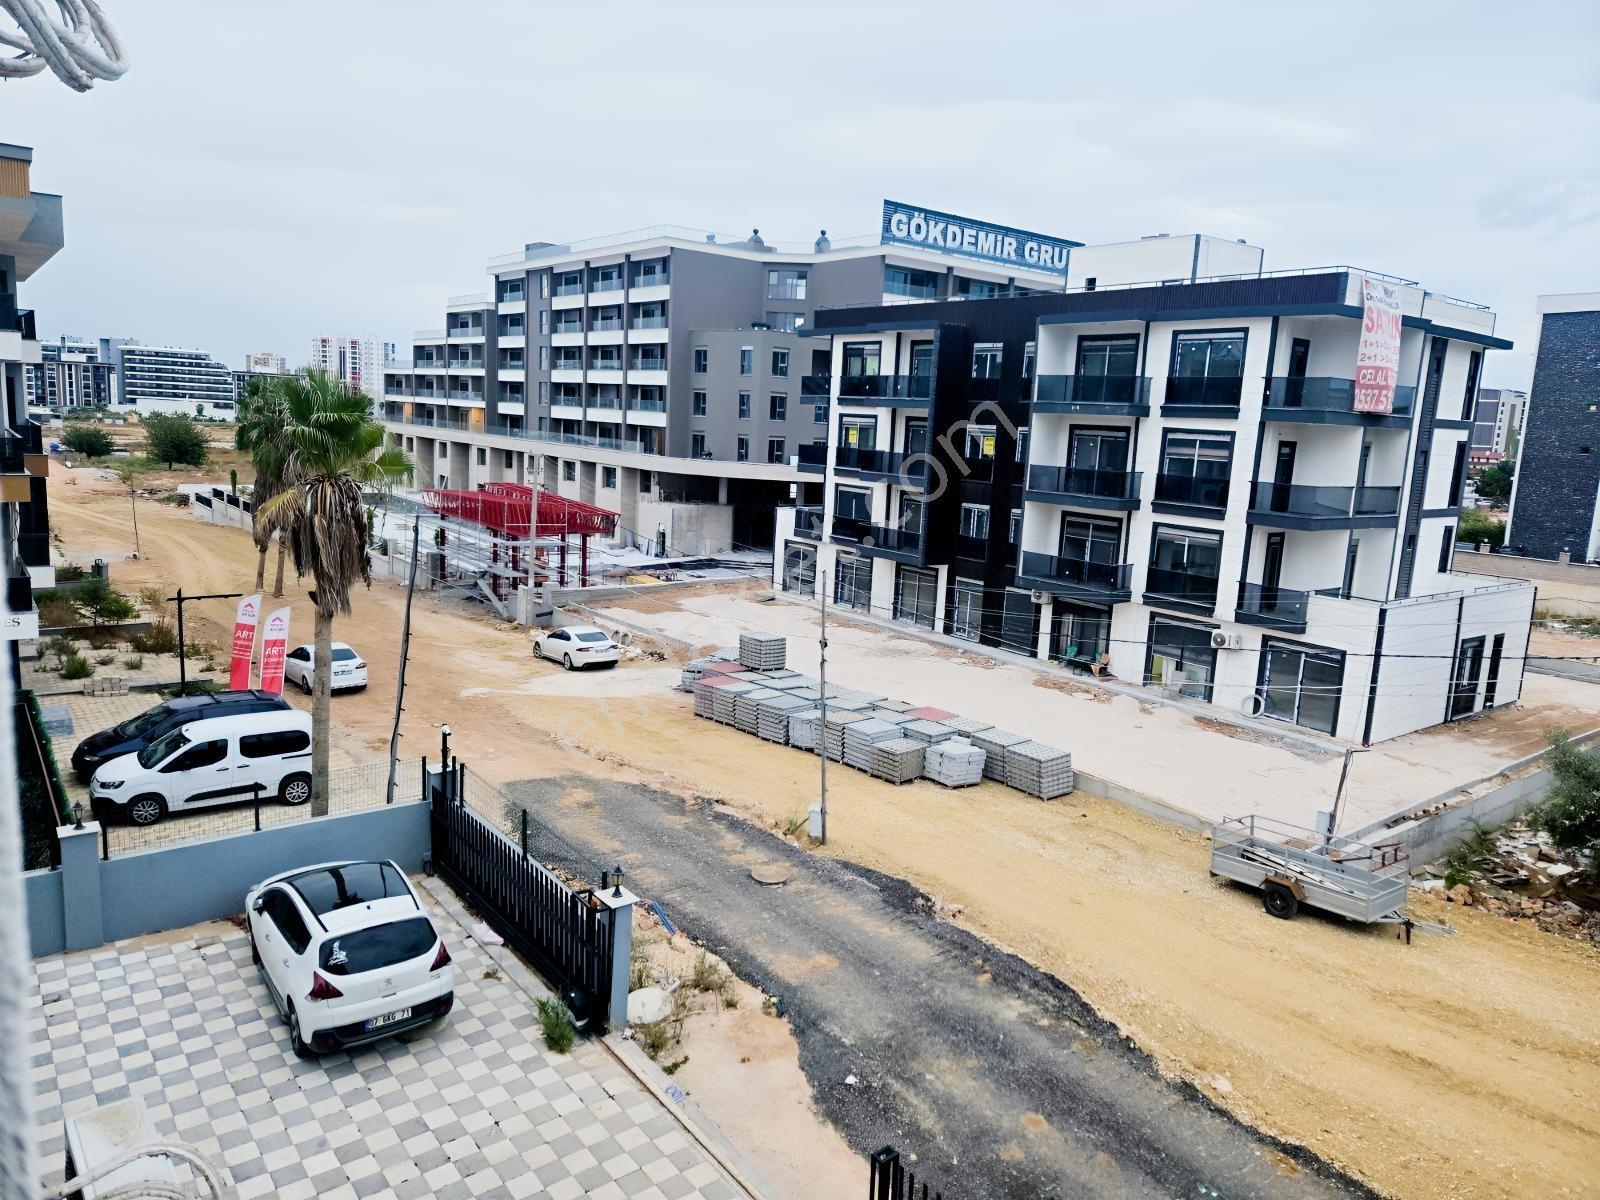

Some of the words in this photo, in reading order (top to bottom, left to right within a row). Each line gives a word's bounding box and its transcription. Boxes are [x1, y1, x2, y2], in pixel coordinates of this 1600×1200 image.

[1024, 241, 1071, 270] GRU
[235, 631, 254, 639] ART
[265, 647, 284, 655] ART
